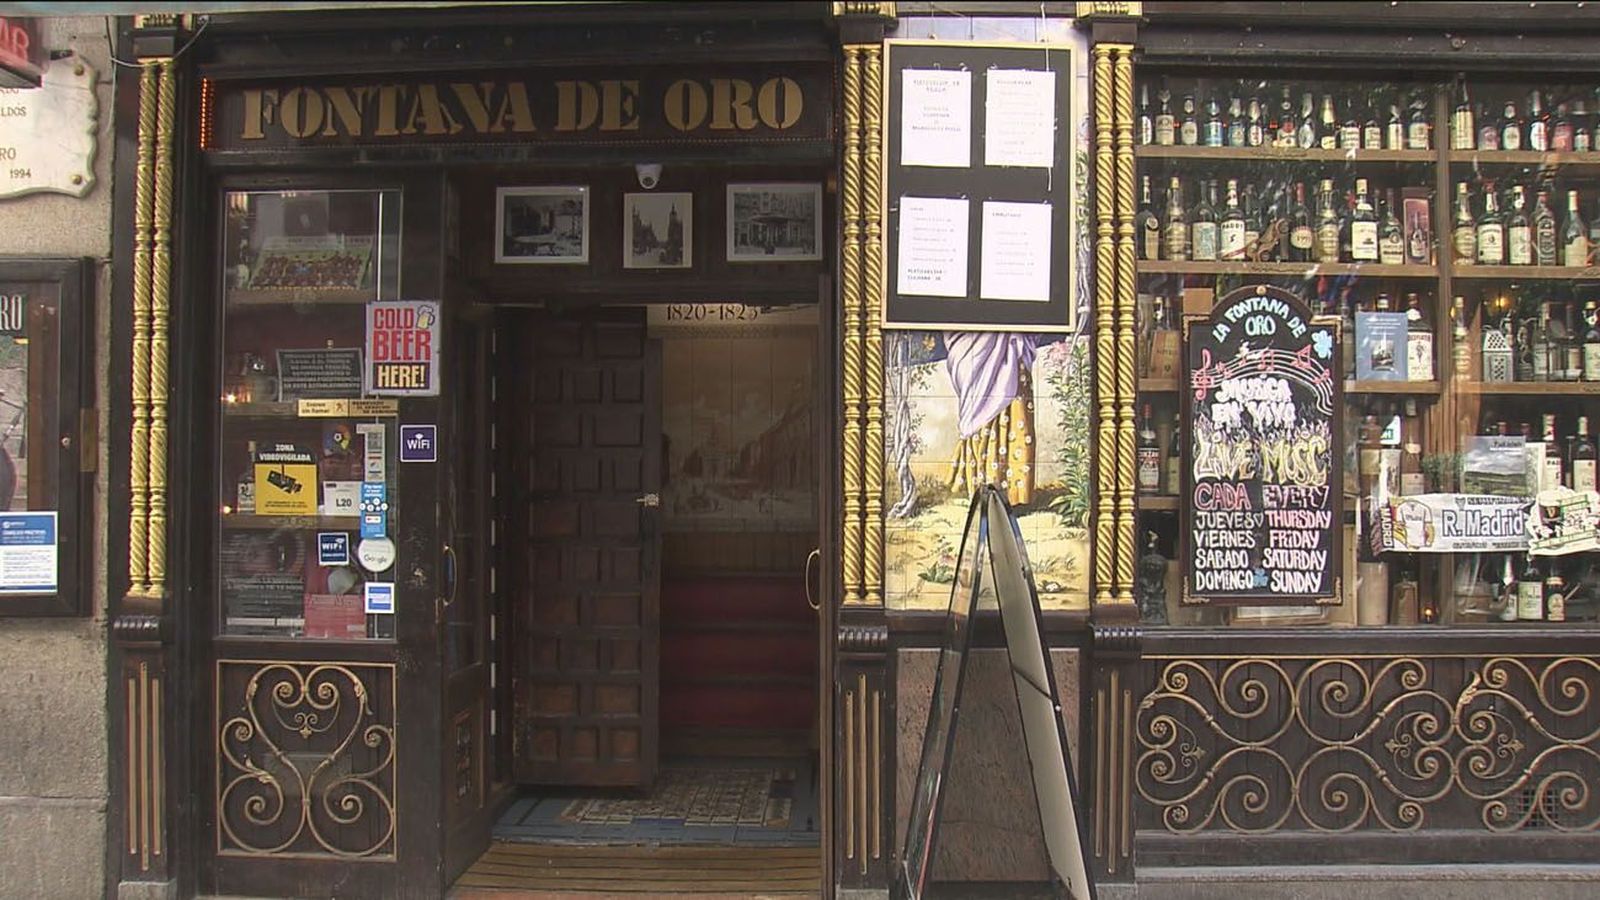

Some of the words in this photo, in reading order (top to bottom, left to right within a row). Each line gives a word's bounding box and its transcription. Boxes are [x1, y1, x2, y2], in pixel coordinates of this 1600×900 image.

[241, 80, 537, 141] FONTANA
[554, 79, 640, 132] DE
[663, 77, 804, 132] ORO
[10, 168, 32, 179] 1994
[374, 308, 415, 329] COLD
[1212, 322, 1231, 343] LA
[1224, 297, 1290, 323] FONTANA
[1286, 316, 1307, 338] DE
[1245, 314, 1276, 336] ORO
[372, 331, 431, 361] BEER
[377, 365, 425, 388] HERE!
[1211, 401, 1243, 433] EN
[259, 453, 312, 462] VIDEOVIGILADA
[275, 444, 295, 452] ZONA
[336, 499, 352, 507] L20
[1194, 482, 1252, 511] CADA
[1262, 485, 1330, 509] EVERY
[1195, 511, 1255, 529] JUEVES
[1265, 510, 1332, 529] THURSDAY
[1442, 509, 1463, 537] R.
[1465, 508, 1526, 537] Madrid
[1195, 548, 1249, 570] SABADO
[1262, 548, 1328, 571] SATURDAY
[1270, 569, 1322, 593] SUNDAY
